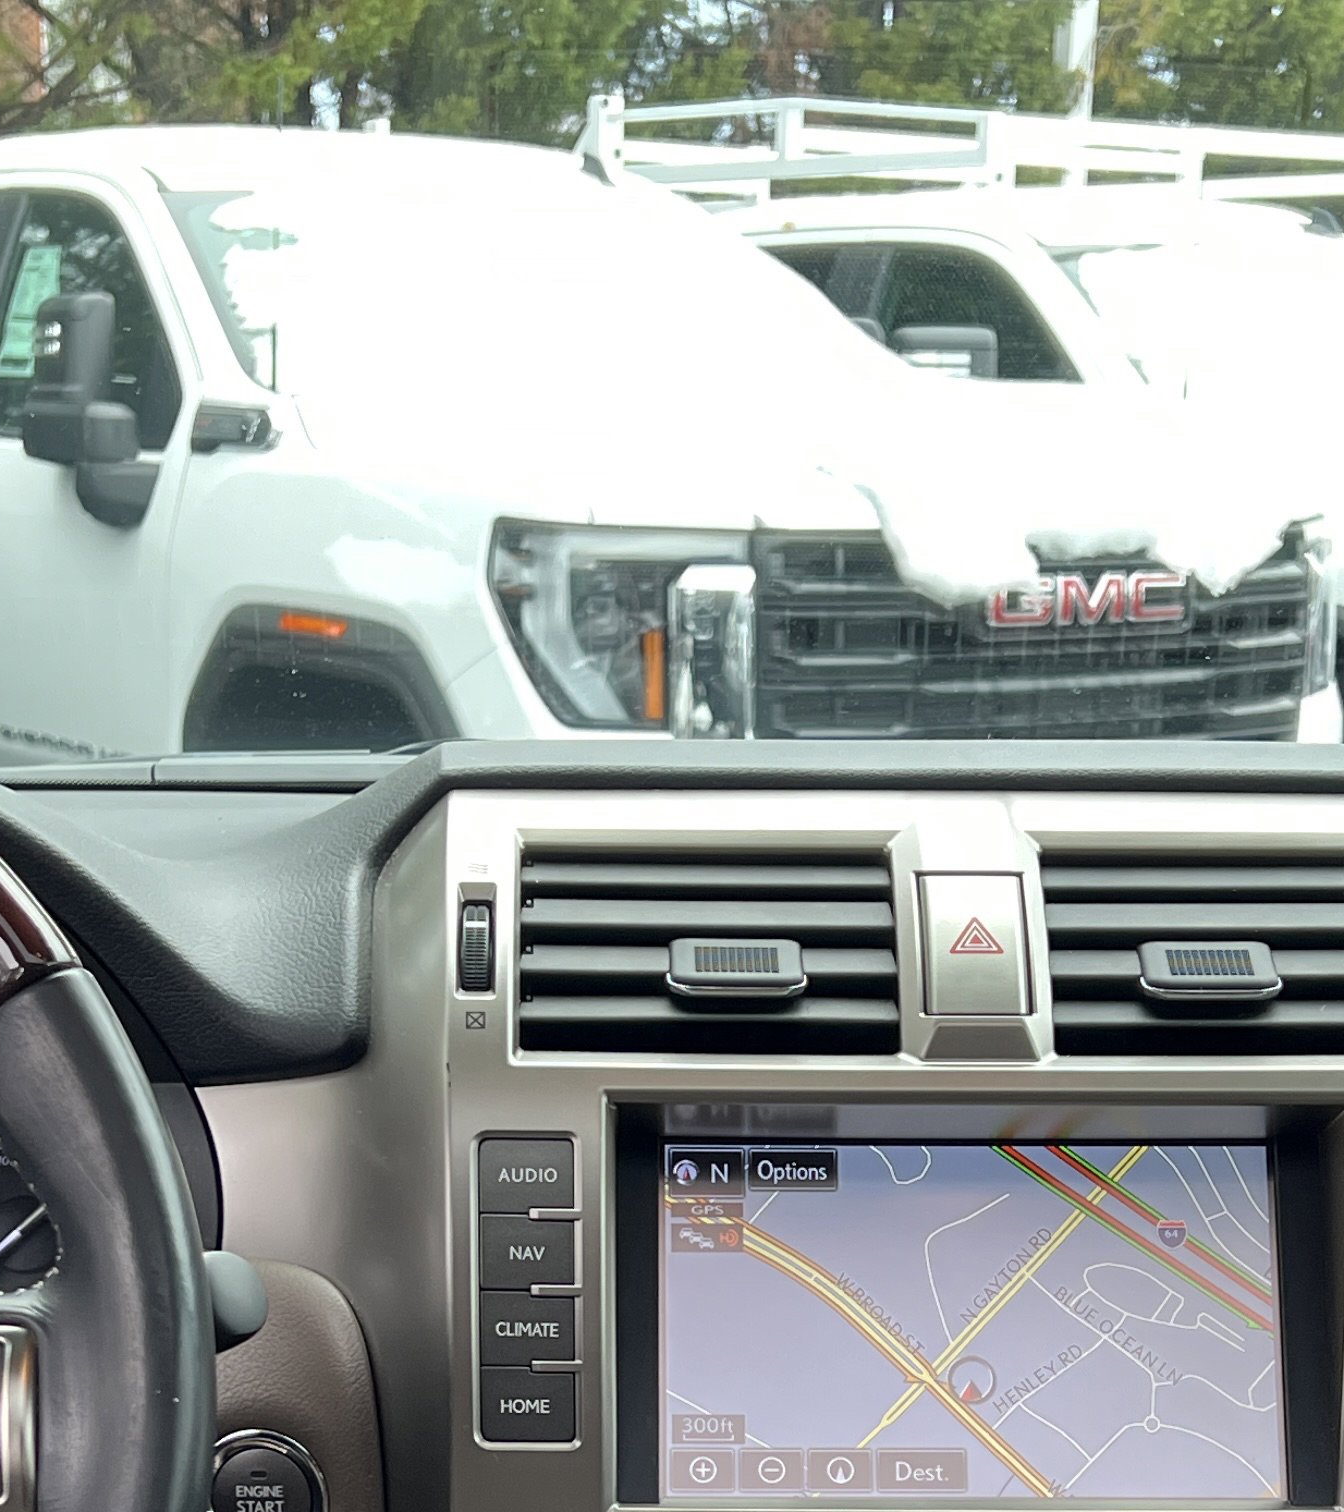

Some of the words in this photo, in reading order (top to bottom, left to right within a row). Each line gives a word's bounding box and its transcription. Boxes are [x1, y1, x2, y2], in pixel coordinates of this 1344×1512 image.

[987, 570, 1186, 628] GMC
[498, 1167, 558, 1184] AUDIO
[710, 1163, 729, 1184] N
[757, 1159, 828, 1185] Options
[690, 1204, 725, 1216] GPS
[508, 1246, 546, 1261] NAV
[959, 1307, 979, 1325] N
[973, 1248, 1033, 1309] GAYTON
[1027, 1227, 1053, 1253] RD
[495, 1321, 560, 1338] CLIMATE
[849, 1285, 904, 1338] BROAD
[904, 1333, 926, 1355] ST
[1053, 1285, 1100, 1325] BLUE
[1098, 1318, 1158, 1369] OCEAN
[1156, 1355, 1184, 1387] LN
[991, 1359, 1057, 1415] HENLEY
[1057, 1343, 1083, 1369] RD
[499, 1399, 551, 1415] HOME
[895, 1460, 950, 1482] Dest.
[235, 1484, 285, 1498] ENGINE
